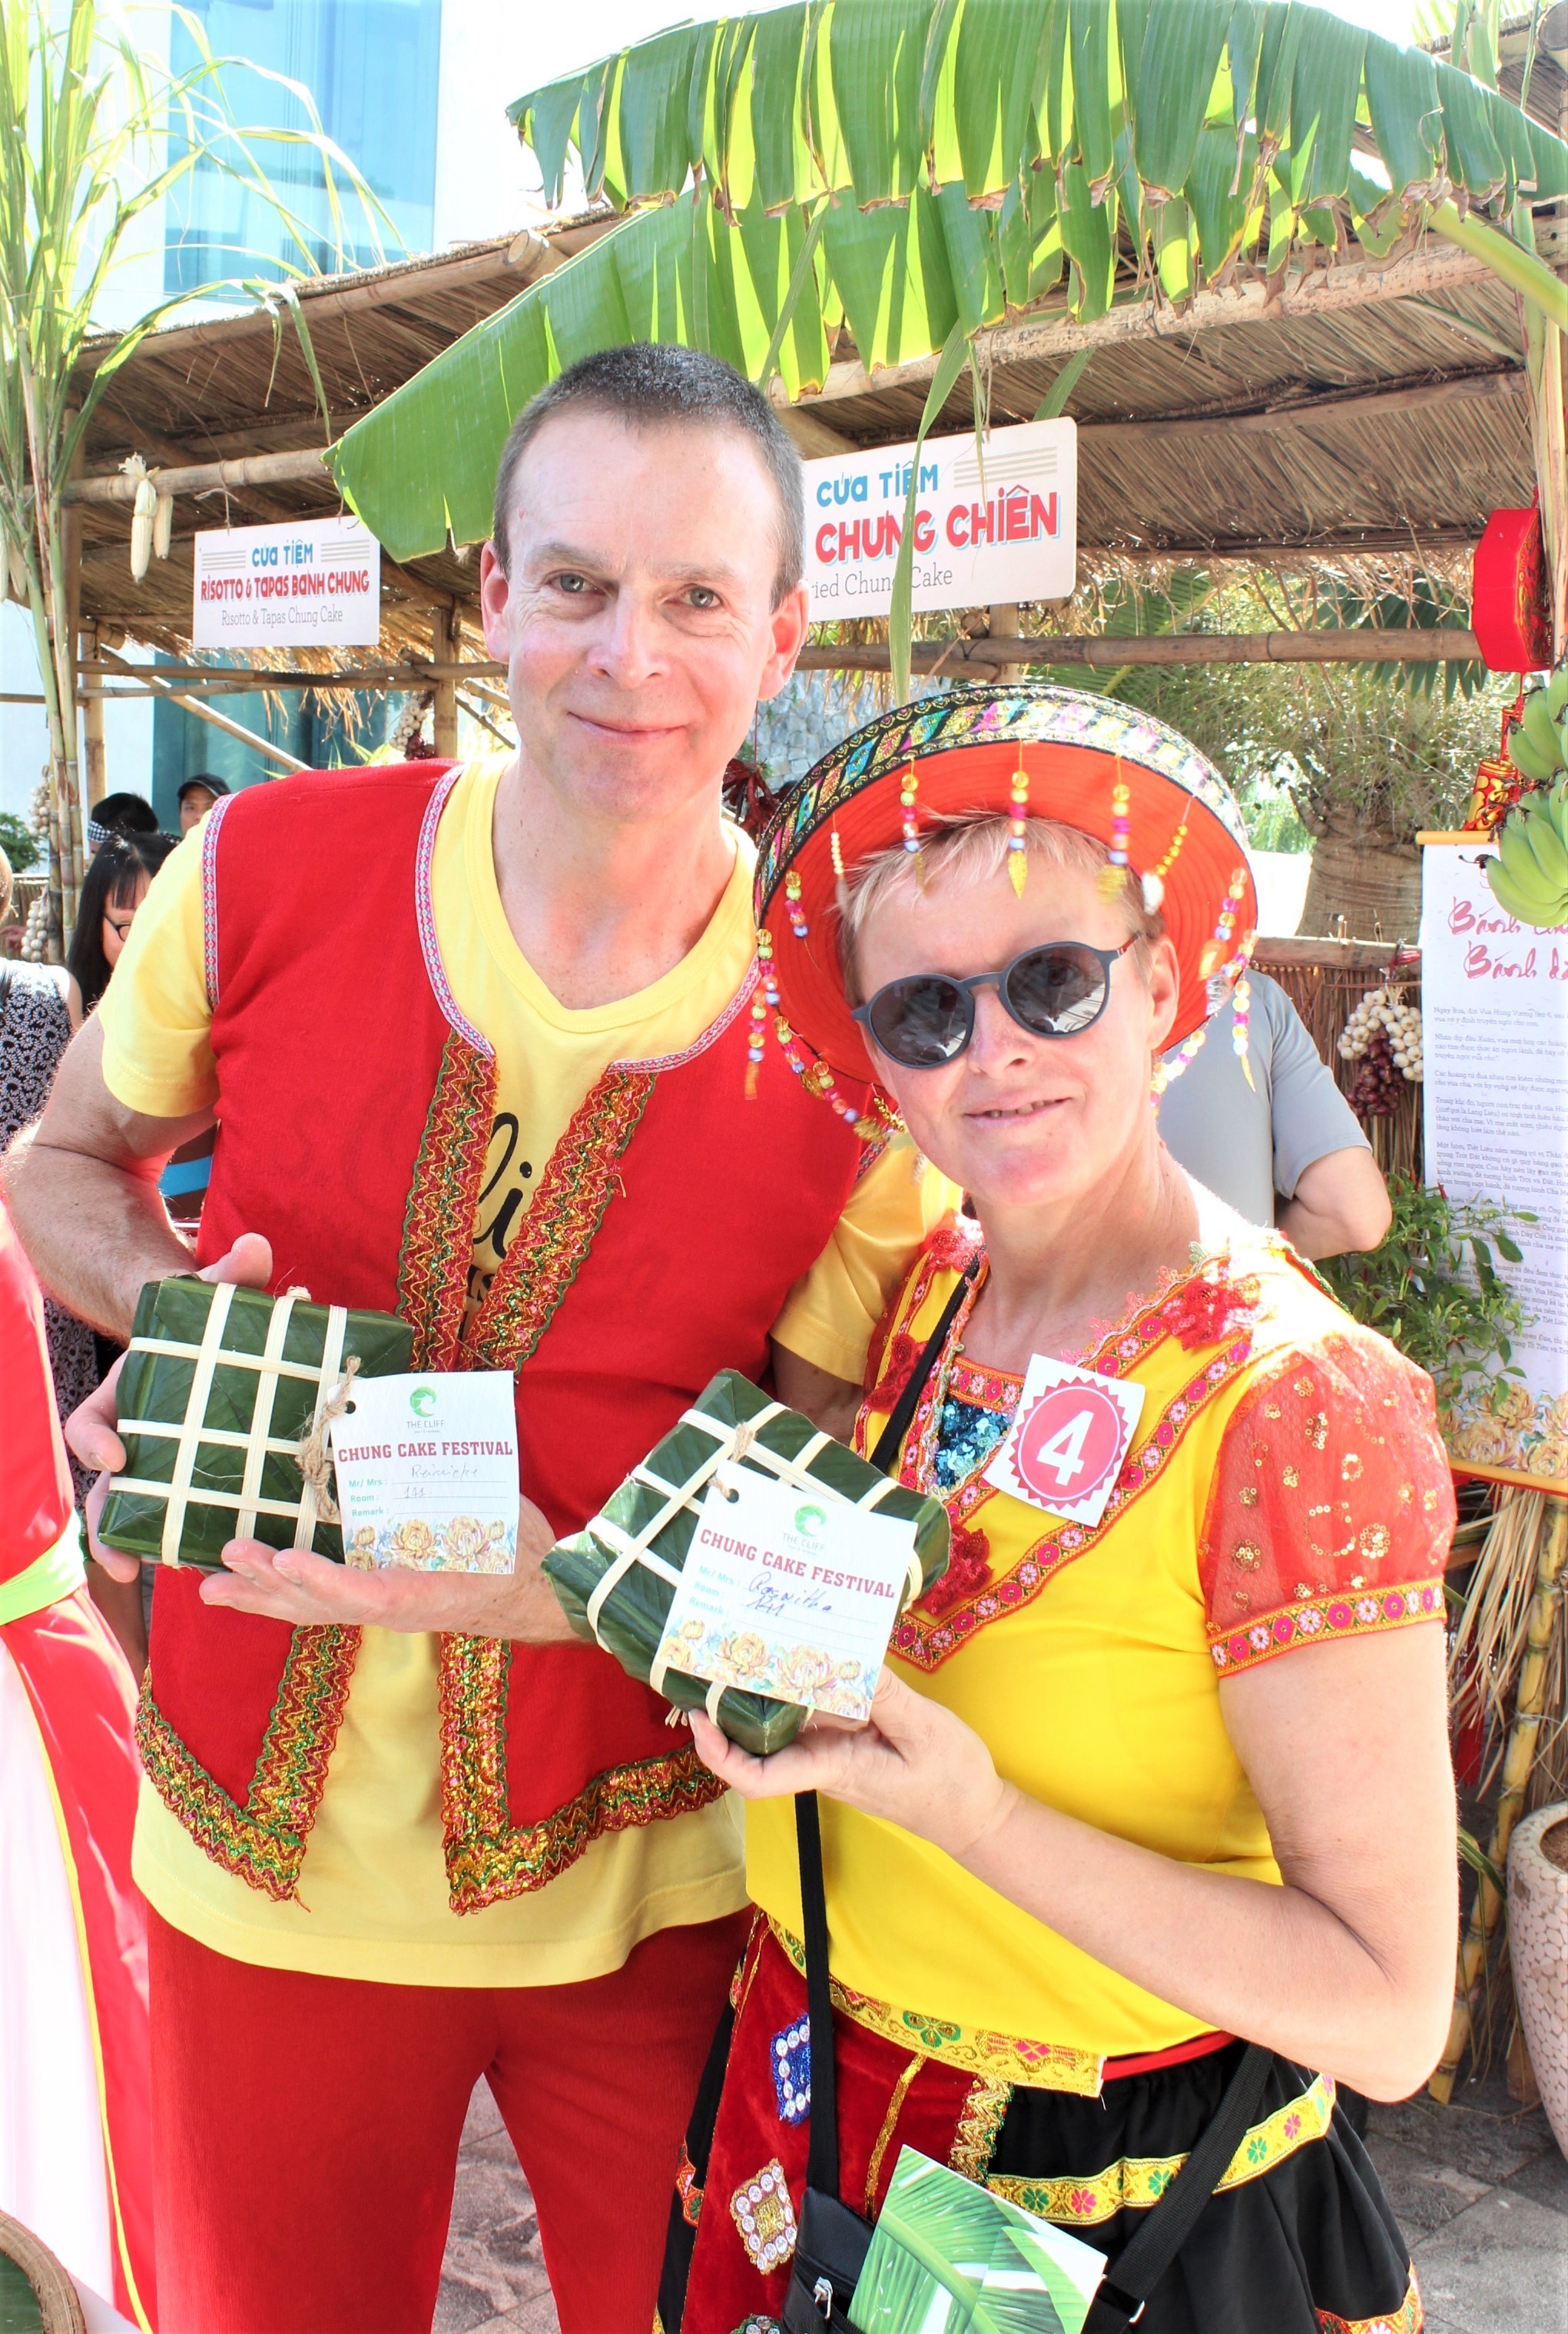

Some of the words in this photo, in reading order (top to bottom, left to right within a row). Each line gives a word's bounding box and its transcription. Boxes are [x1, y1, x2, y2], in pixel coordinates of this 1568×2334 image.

[246, 579, 252, 598] &
[845, 570, 892, 595] Chun
[911, 562, 953, 589] Cake
[222, 610, 250, 625] Risotto
[253, 609, 258, 624] &
[261, 608, 286, 628] Tapas
[288, 605, 318, 627] Chung
[320, 604, 343, 623] Cake
[1464, 940, 1537, 980] Bánh
[406, 1420, 422, 1429] THE
[424, 1420, 445, 1428] CLIFF
[338, 1444, 392, 1462] CHUNG
[398, 1442, 437, 1457] CAKE
[442, 1441, 513, 1456] FESTIVAL
[1036, 1410, 1095, 1487] 4
[782, 1531, 800, 1544] THE
[801, 1539, 826, 1551] CLIFF
[700, 1529, 757, 1561] CHUNG
[762, 1551, 807, 1577] CAKE
[811, 1566, 895, 1599] FESTIVAL
